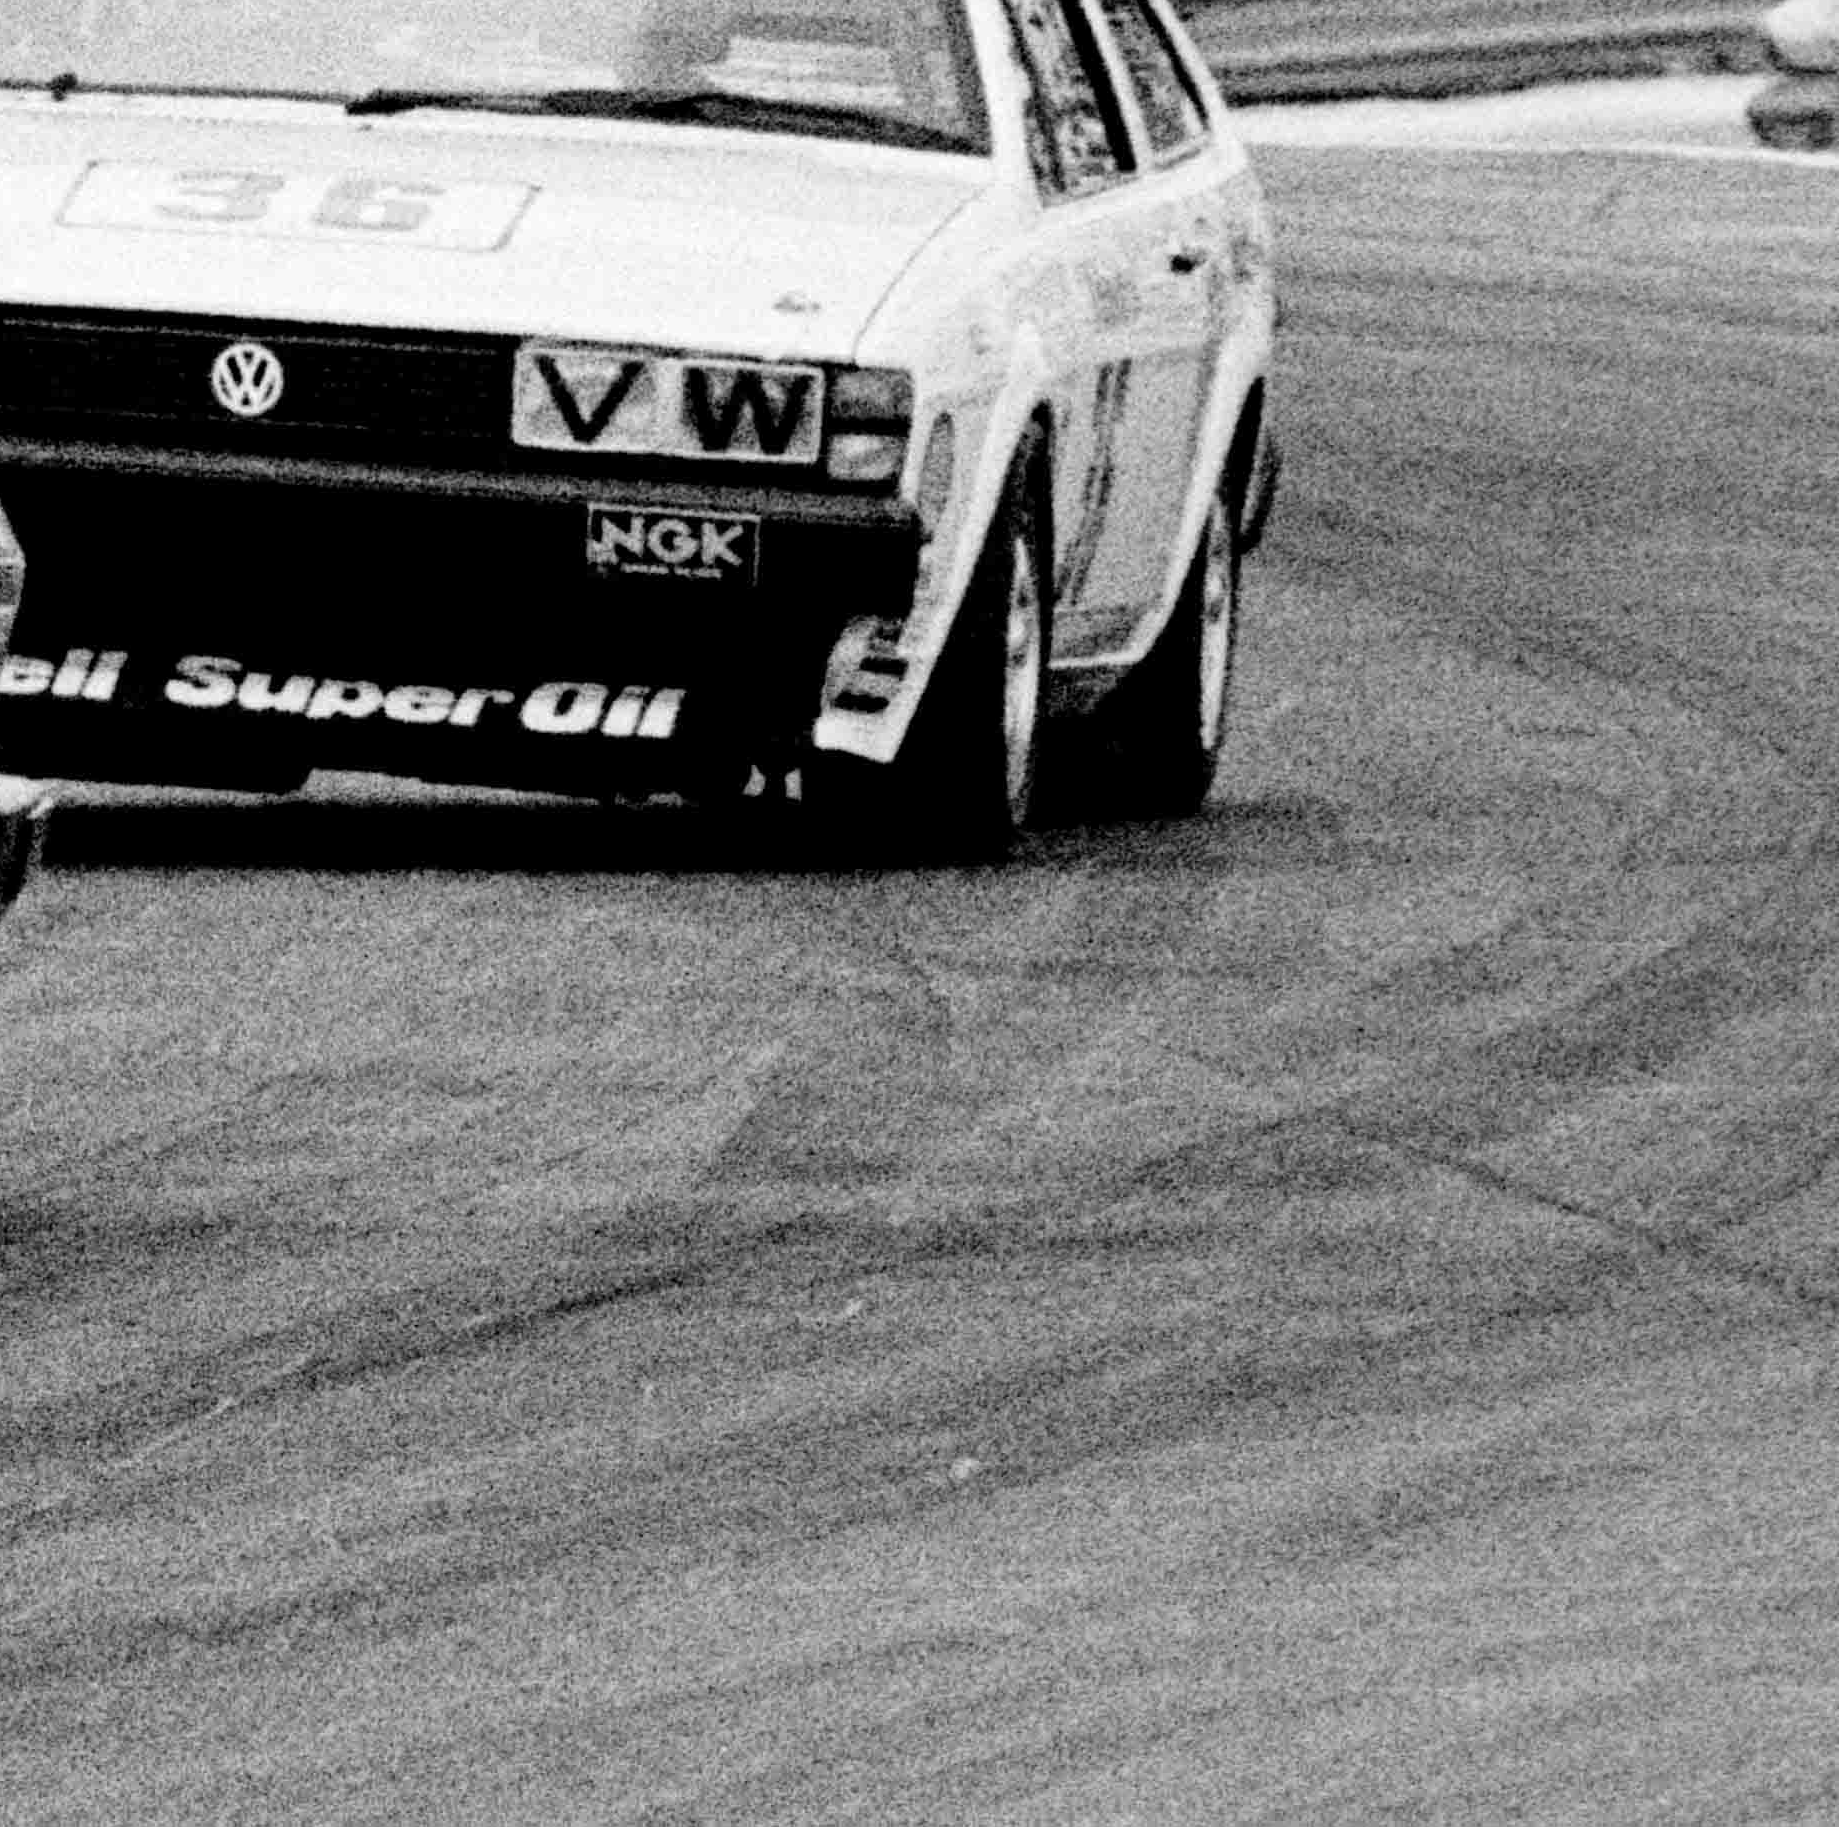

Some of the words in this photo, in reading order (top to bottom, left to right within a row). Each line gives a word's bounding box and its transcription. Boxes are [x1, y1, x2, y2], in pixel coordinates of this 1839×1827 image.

[155, 171, 445, 230] 36
[589, 516, 744, 566] NGK
[165, 655, 515, 728] Super
[519, 681, 687, 739] Oil
